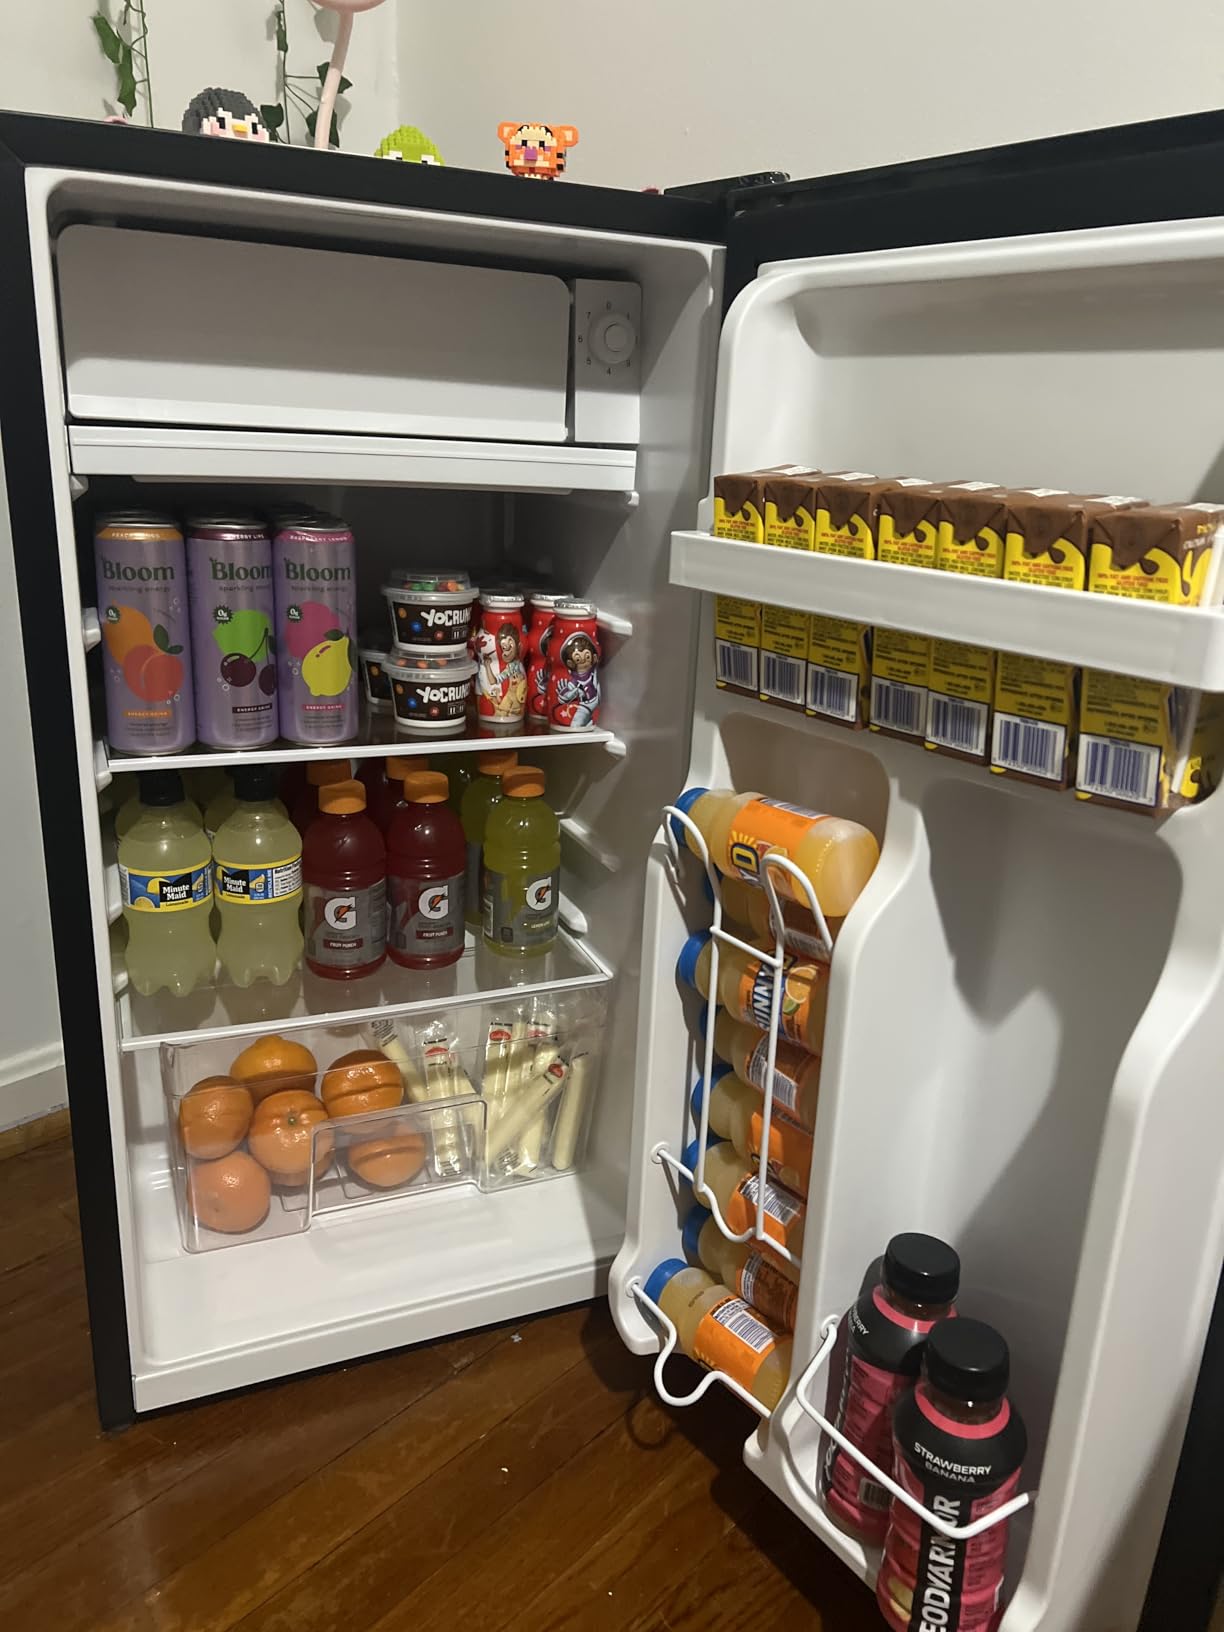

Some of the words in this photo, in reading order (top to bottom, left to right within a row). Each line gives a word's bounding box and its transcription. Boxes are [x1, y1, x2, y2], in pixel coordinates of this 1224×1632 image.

[101, 557, 175, 581] Bloom
[284, 558, 351, 581] Bloom
[420, 607, 472, 627] YOCRUN
[415, 683, 470, 703] YOCRUN
[162, 884, 190, 894] Minute
[223, 877, 247, 886] Minute
[226, 884, 244, 893] Maid
[166, 892, 187, 900] Maid
[418, 885, 449, 920] G
[526, 876, 552, 911] G
[324, 896, 357, 930] G
[914, 1441, 992, 1475] STRAWBERRY
[925, 1461, 976, 1483] BANANA
